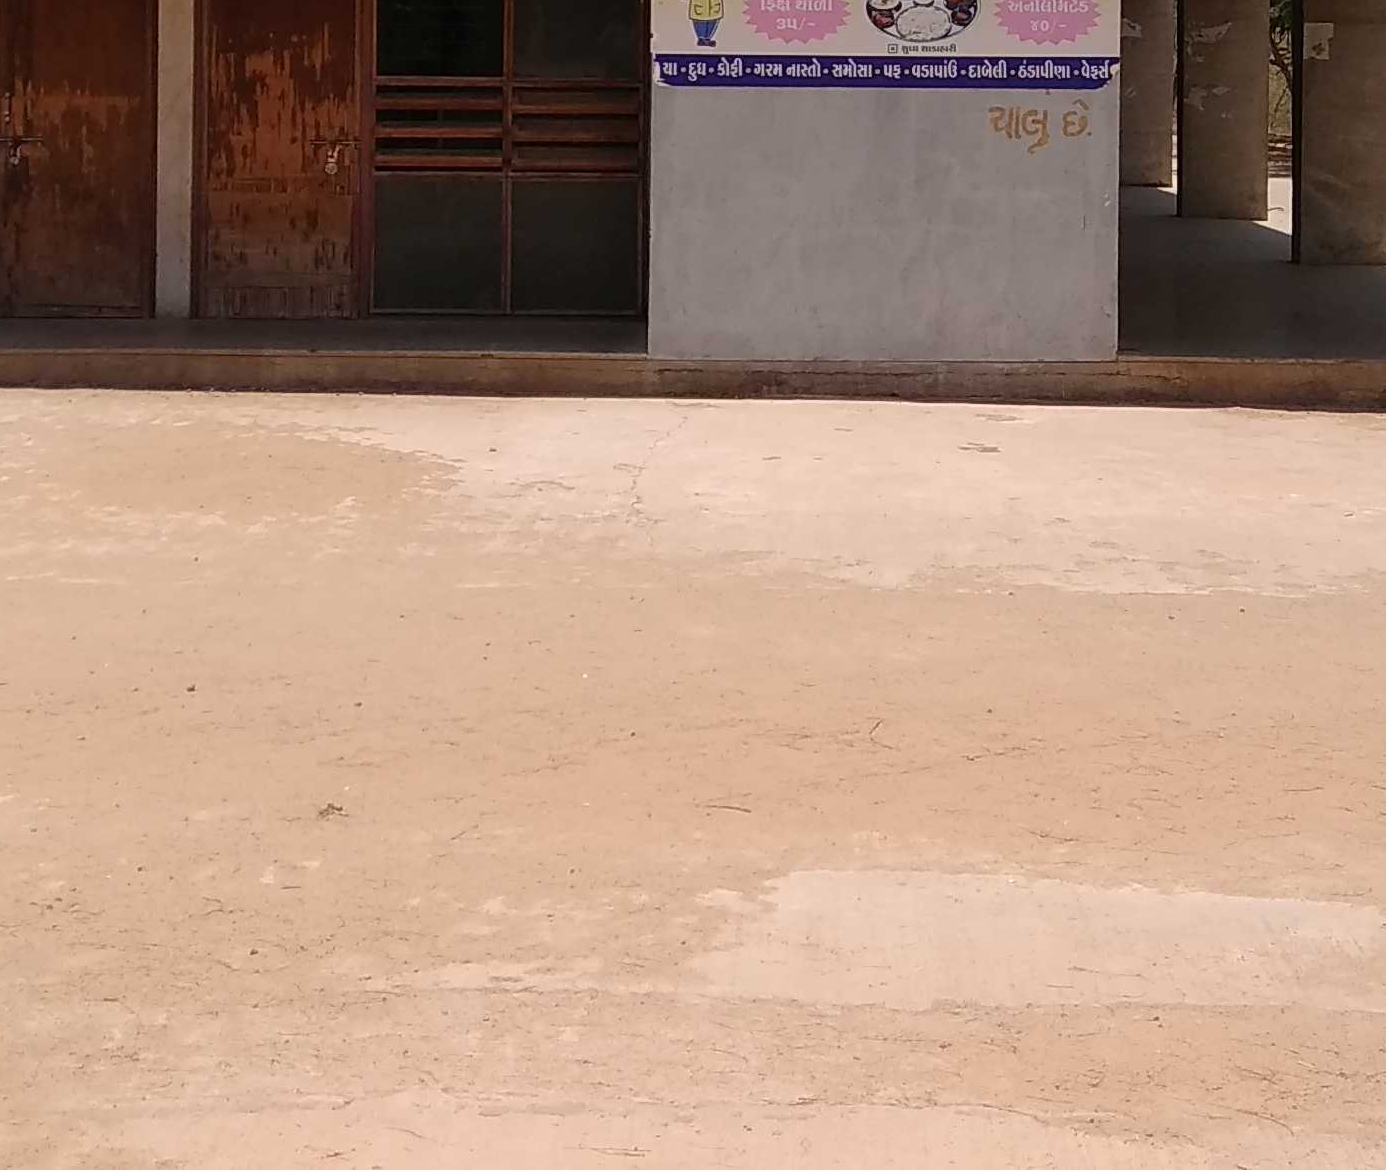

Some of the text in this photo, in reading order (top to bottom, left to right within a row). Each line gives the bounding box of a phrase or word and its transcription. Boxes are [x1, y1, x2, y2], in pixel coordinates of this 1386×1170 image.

[753, 63, 784, 78] ગરમ
[786, 57, 821, 78] નાસ્તો
[831, 58, 873, 78] સમોસા
[968, 59, 1007, 79] દાબેલી
[1017, 59, 1071, 79] ઠંડાપીણા
[988, 106, 1050, 155] ચાલુ
